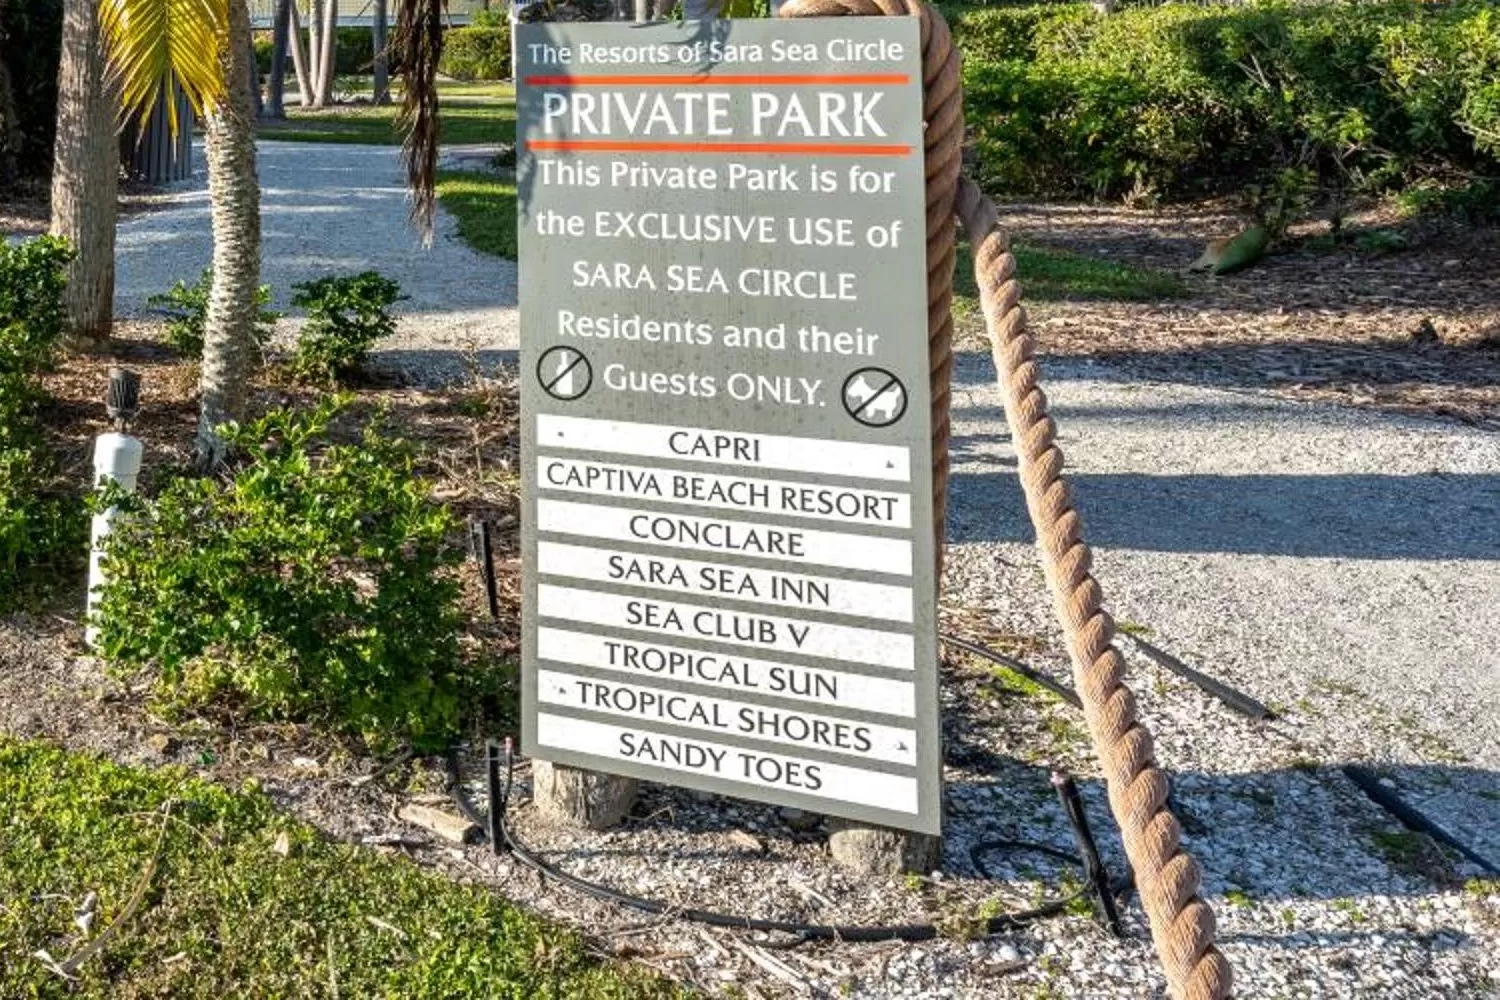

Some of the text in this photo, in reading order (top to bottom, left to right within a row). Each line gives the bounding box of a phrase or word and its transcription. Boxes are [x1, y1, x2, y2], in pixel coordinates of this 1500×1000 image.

[528, 39, 903, 65] The Resorts of Sara Sea Circle
[543, 91, 887, 137] PRIVATE PARK
[538, 160, 896, 193] This Private Park is for
[537, 211, 901, 248] the EXCLUSIVE USE of
[573, 261, 856, 300] SARA SEA CIRCLE
[558, 311, 878, 355] Residents and their
[604, 364, 826, 407] Guests ONLY.
[669, 432, 760, 461] CAPRI
[547, 463, 898, 520] CAPTIVA BEACH RESORT
[629, 515, 804, 557] CONCLARE
[608, 556, 830, 606] SARA SEA INN
[627, 602, 810, 648] SEA CLUB V
[604, 642, 838, 700] TROPICAL SUN
[576, 681, 871, 752] TROPICAL SHORES
[620, 733, 822, 790] SANDY TOES
